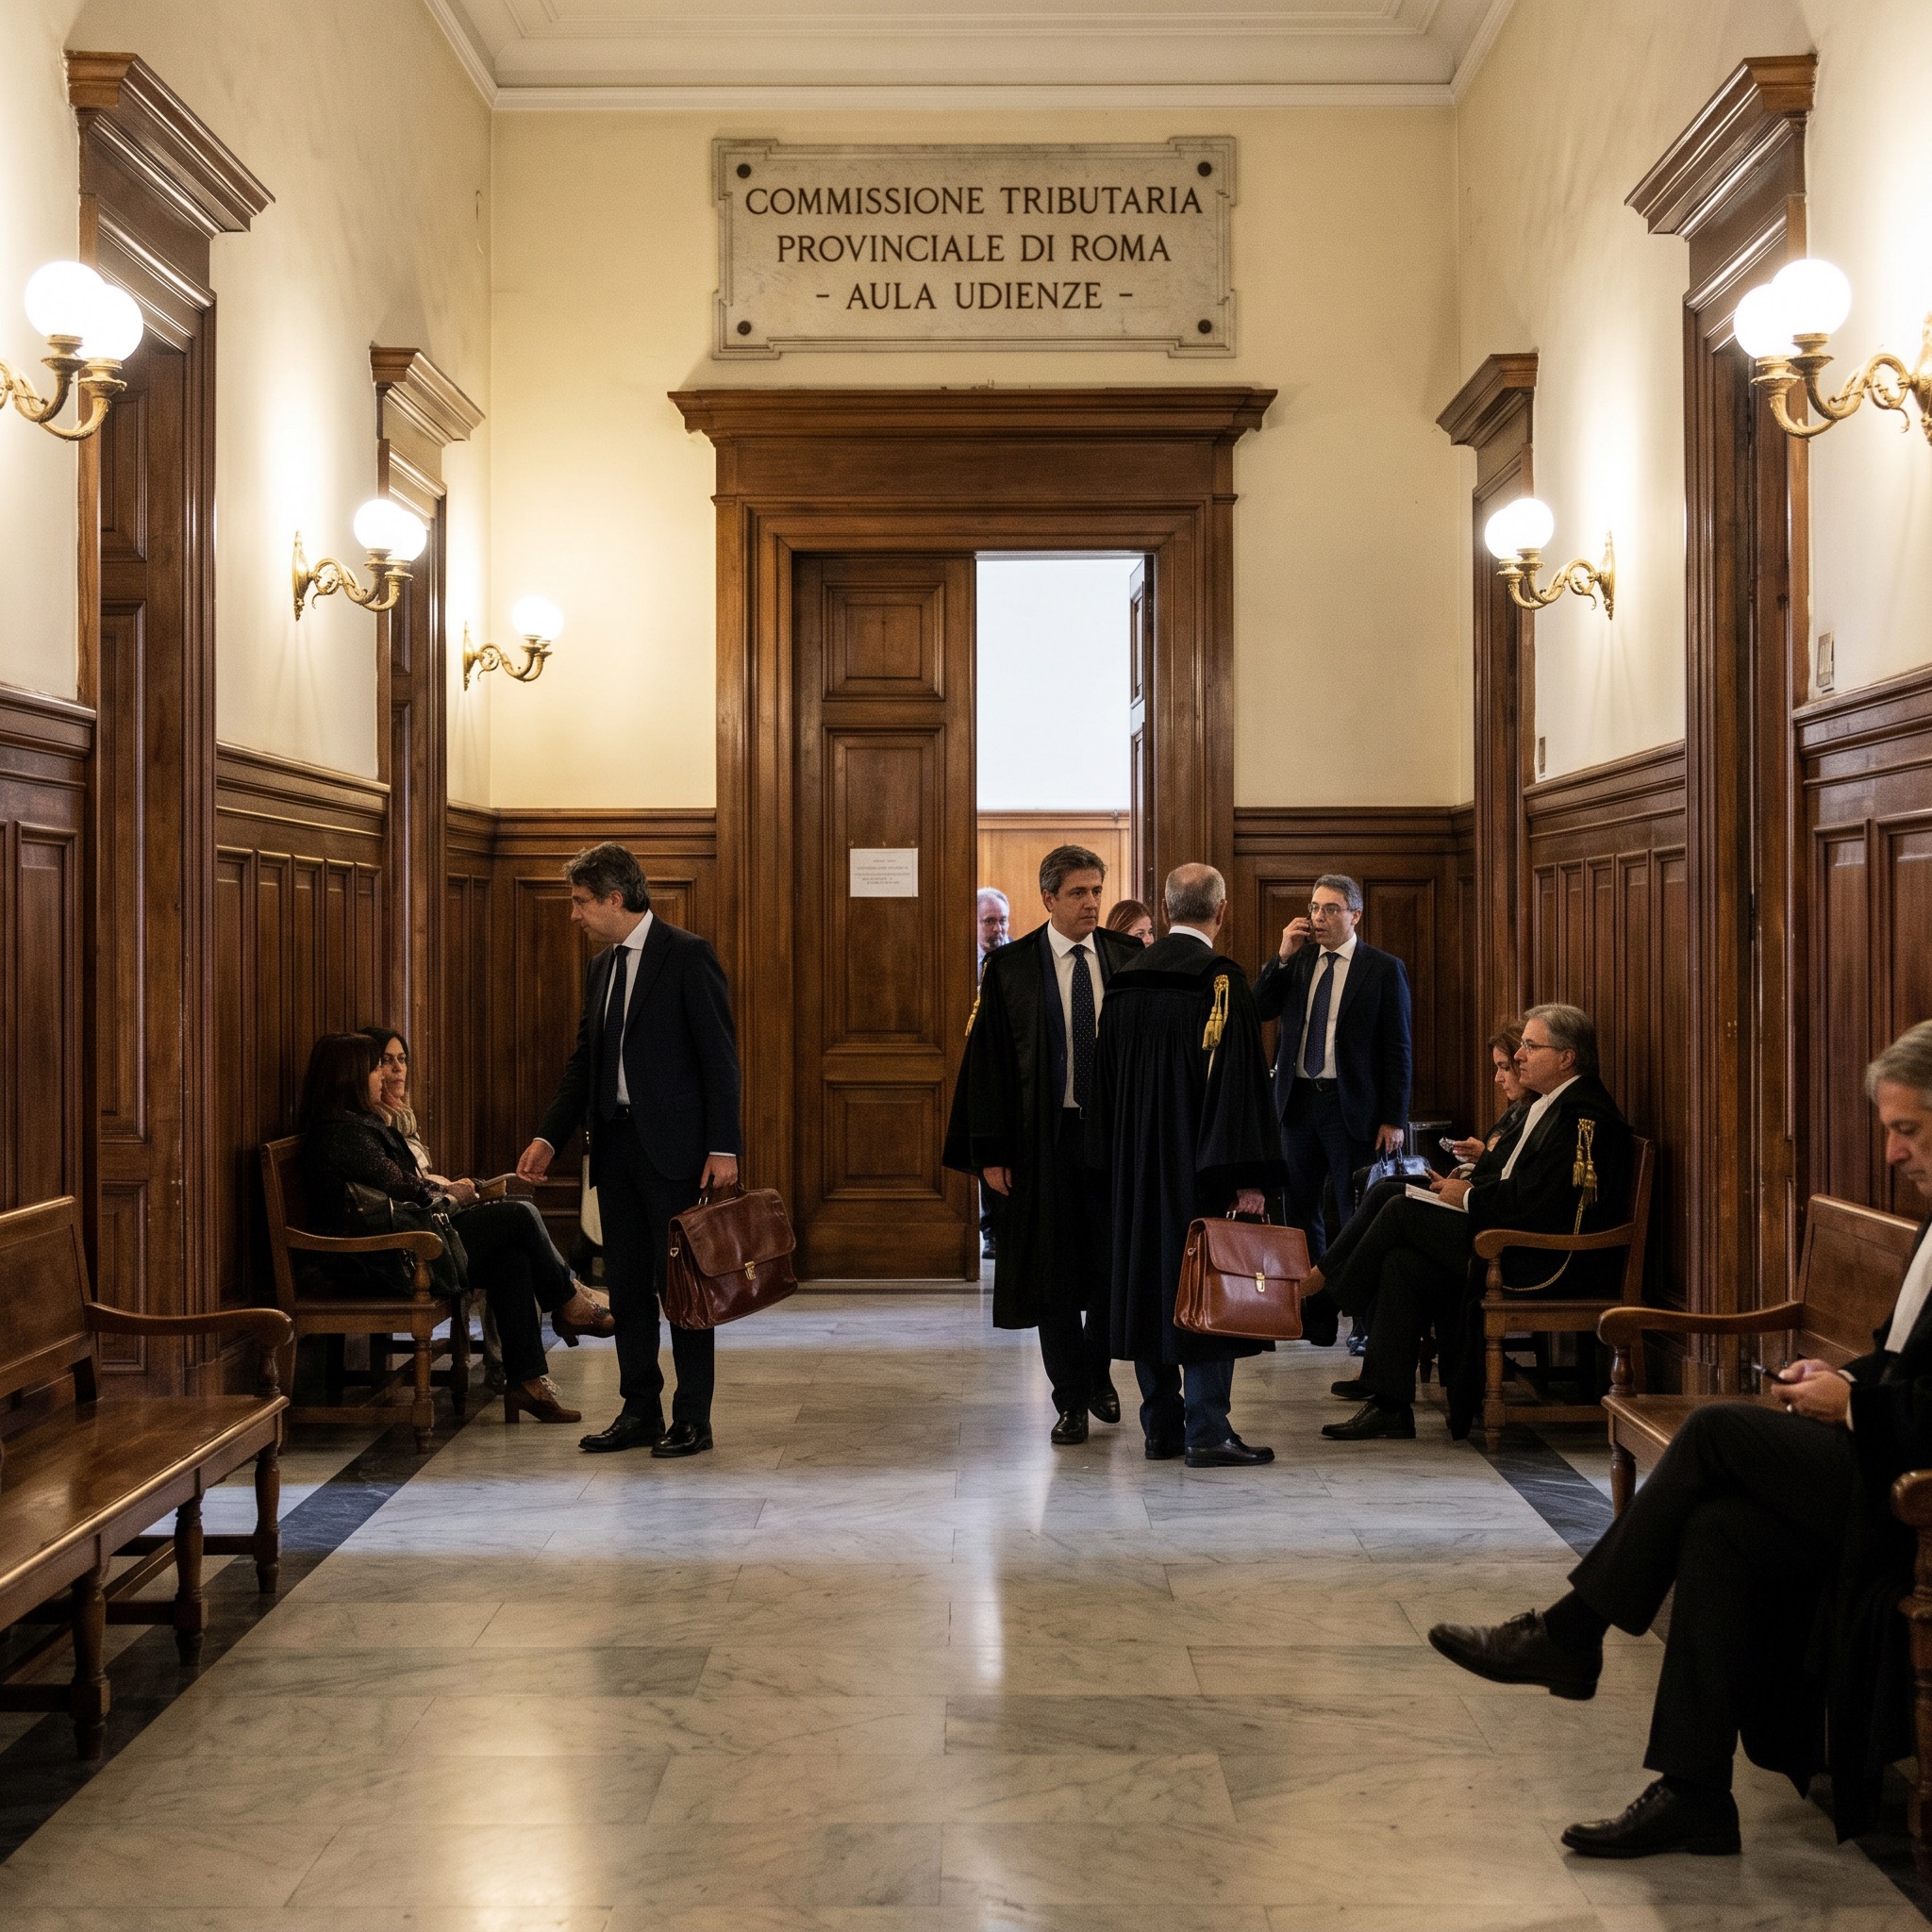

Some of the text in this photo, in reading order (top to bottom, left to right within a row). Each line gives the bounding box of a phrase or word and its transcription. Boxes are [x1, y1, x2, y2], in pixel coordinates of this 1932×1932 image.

[745, 186, 1204, 215] COMMISSIONE TRIBUTARIA
[776, 234, 1172, 263] PROVINCIALE DI ROMA
[845, 282, 938, 310] AULA
[954, 282, 1103, 310] UDIENZE
